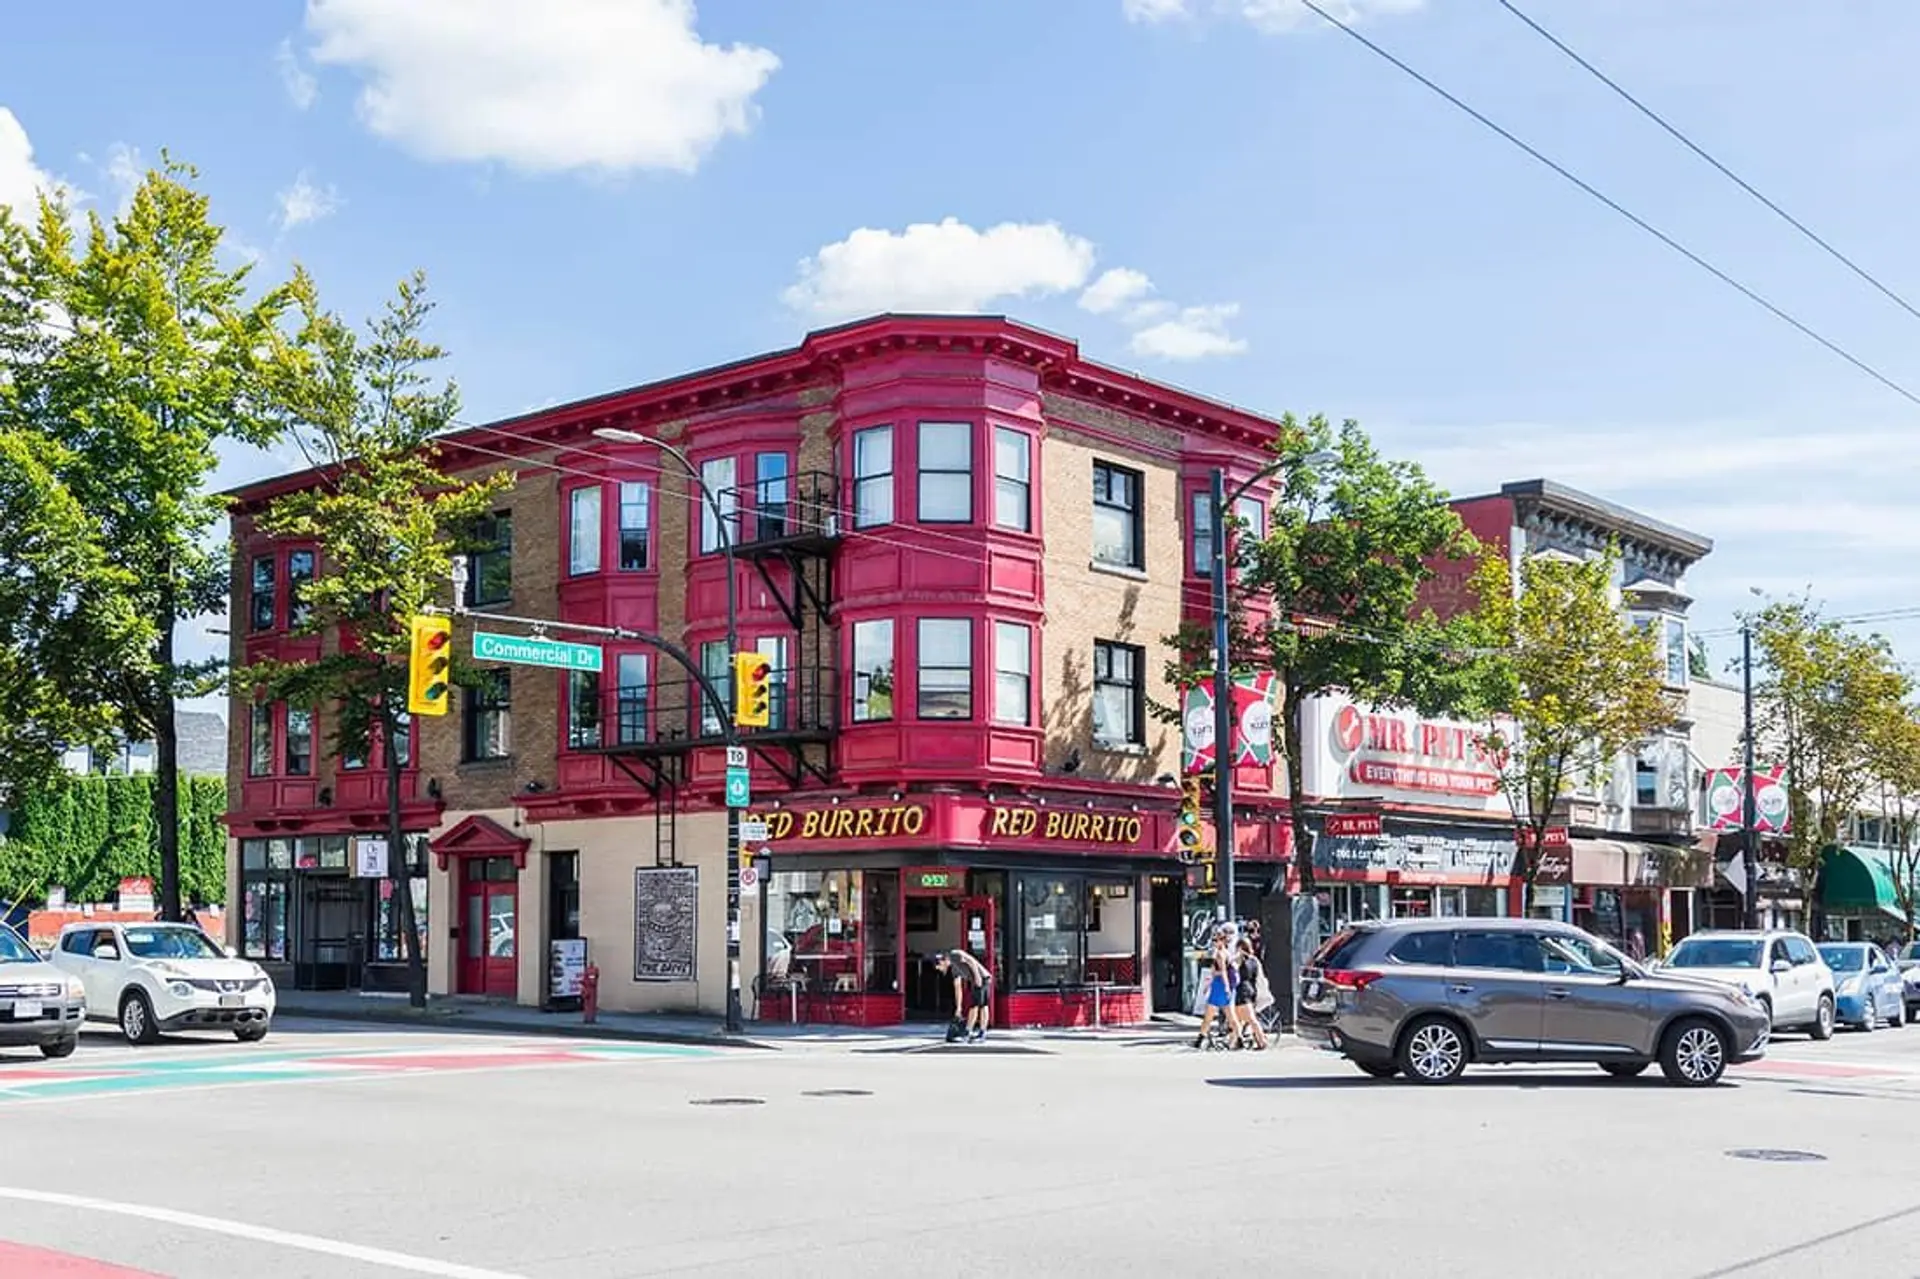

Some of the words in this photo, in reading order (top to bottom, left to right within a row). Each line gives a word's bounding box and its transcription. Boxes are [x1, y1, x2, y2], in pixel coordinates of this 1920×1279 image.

[481, 638, 572, 663] Commercial
[577, 649, 594, 666] Dr
[730, 750, 745, 763] TO
[1366, 765, 1427, 784] EVERYTHING
[1429, 771, 1448, 787] FOR
[802, 804, 924, 838] BURRITO
[991, 807, 1038, 836] RED
[1045, 811, 1141, 843] BURRITO
